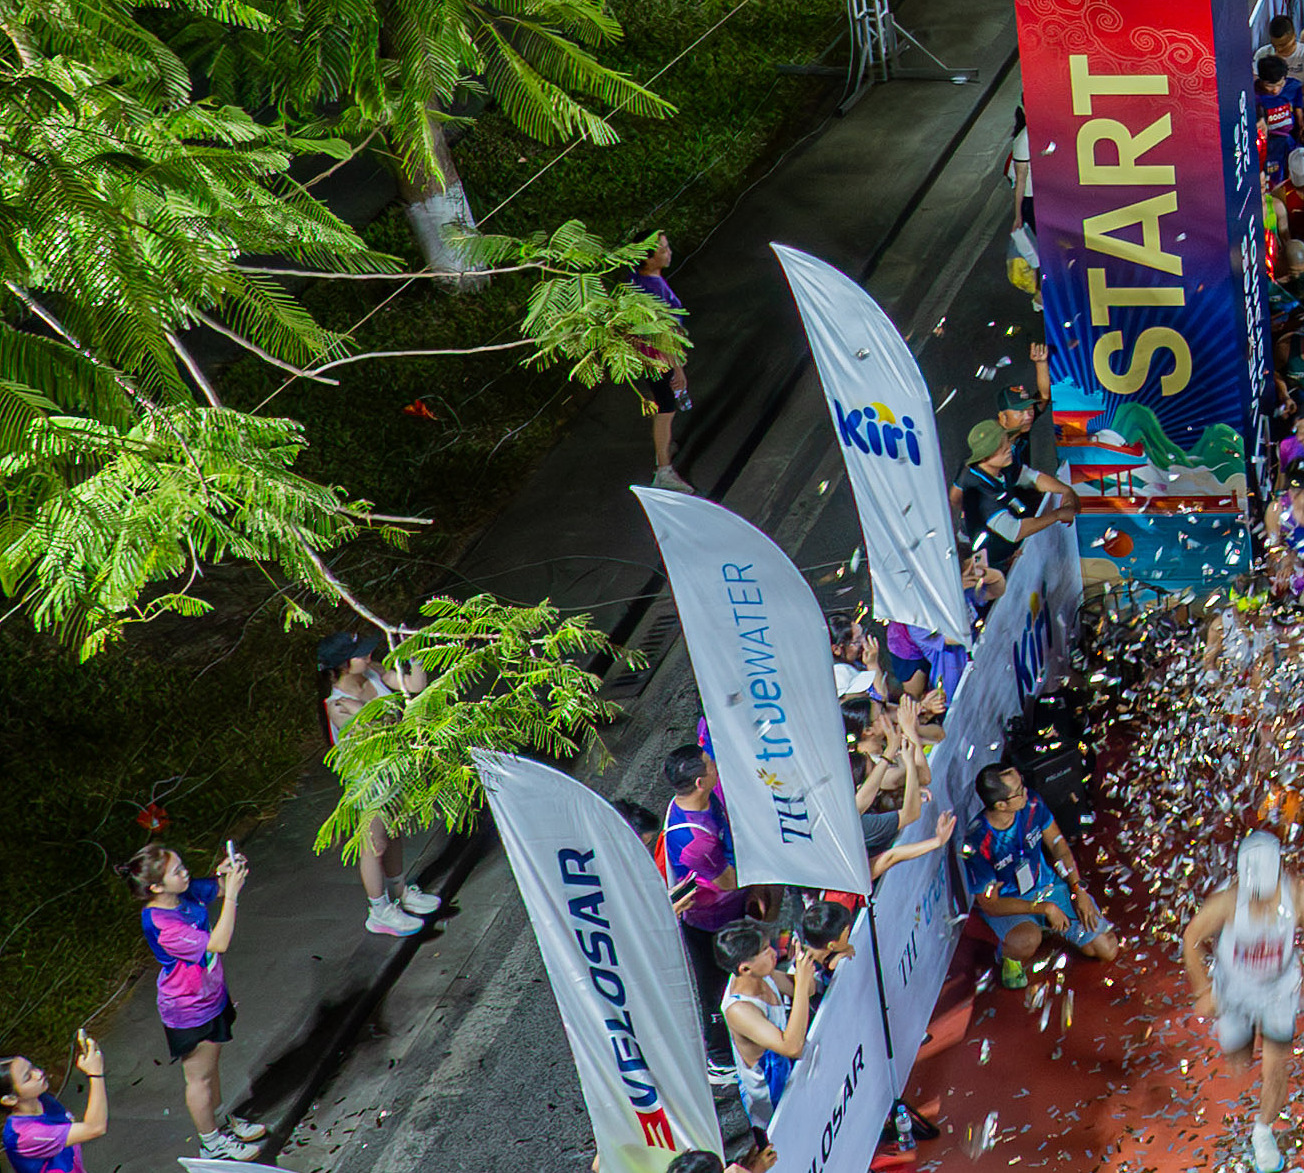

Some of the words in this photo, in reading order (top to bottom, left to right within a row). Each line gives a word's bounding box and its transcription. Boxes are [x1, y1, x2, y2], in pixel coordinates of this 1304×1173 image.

[1239, 90, 1250, 173] 2026
[1069, 54, 1192, 397] START
[834, 399, 921, 466] Kiri
[770, 789, 814, 844] TH
[558, 848, 657, 1107] VELOSAR
